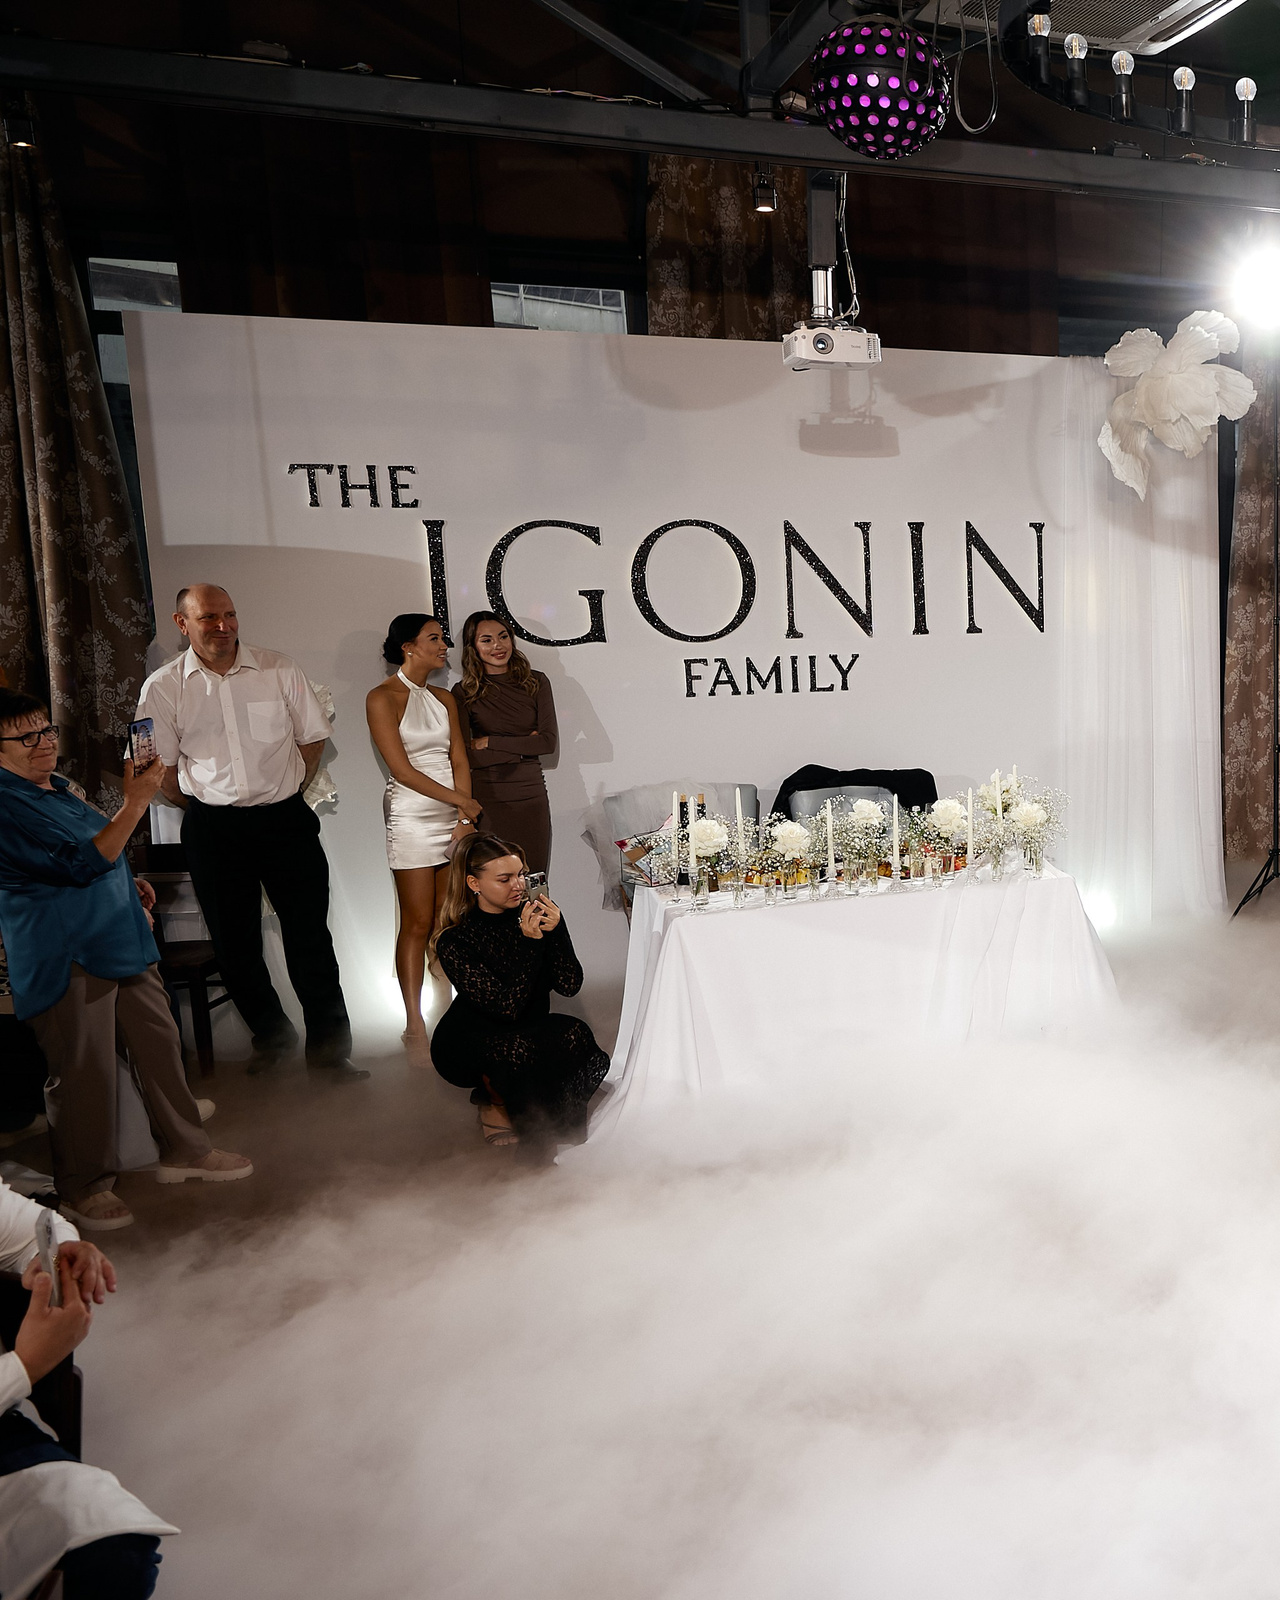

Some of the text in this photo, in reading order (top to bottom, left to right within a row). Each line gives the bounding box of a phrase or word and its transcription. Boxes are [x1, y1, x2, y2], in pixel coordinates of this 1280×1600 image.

[288, 464, 419, 508] THE
[421, 519, 1045, 648] IGONIN
[683, 653, 861, 698] FAMILY
